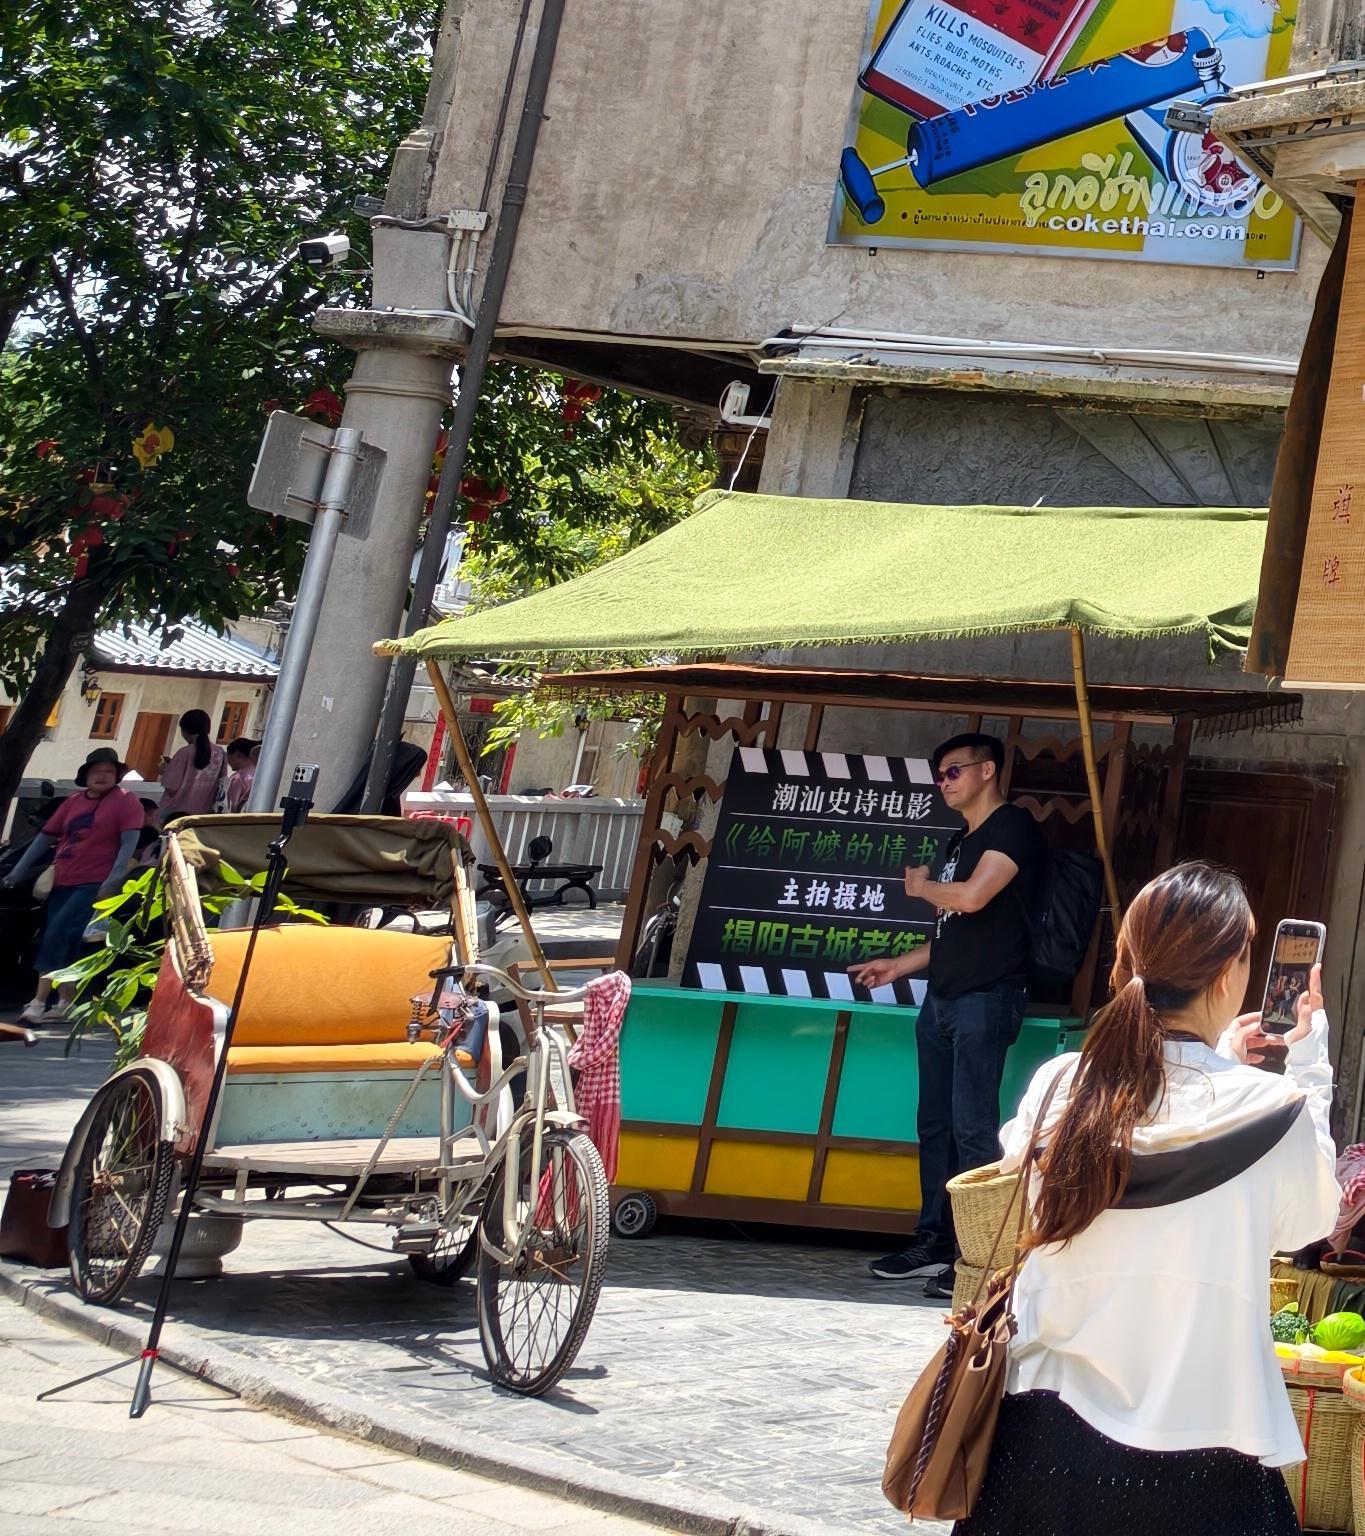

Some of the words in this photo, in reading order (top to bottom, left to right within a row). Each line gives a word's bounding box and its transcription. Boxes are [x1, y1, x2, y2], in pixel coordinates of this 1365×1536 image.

[924, 4, 970, 39] KILLS
[1049, 213, 1248, 241] cokethai.com
[772, 782, 933, 820] 潮汕史诗电影
[777, 877, 885, 912] 主拍摄地
